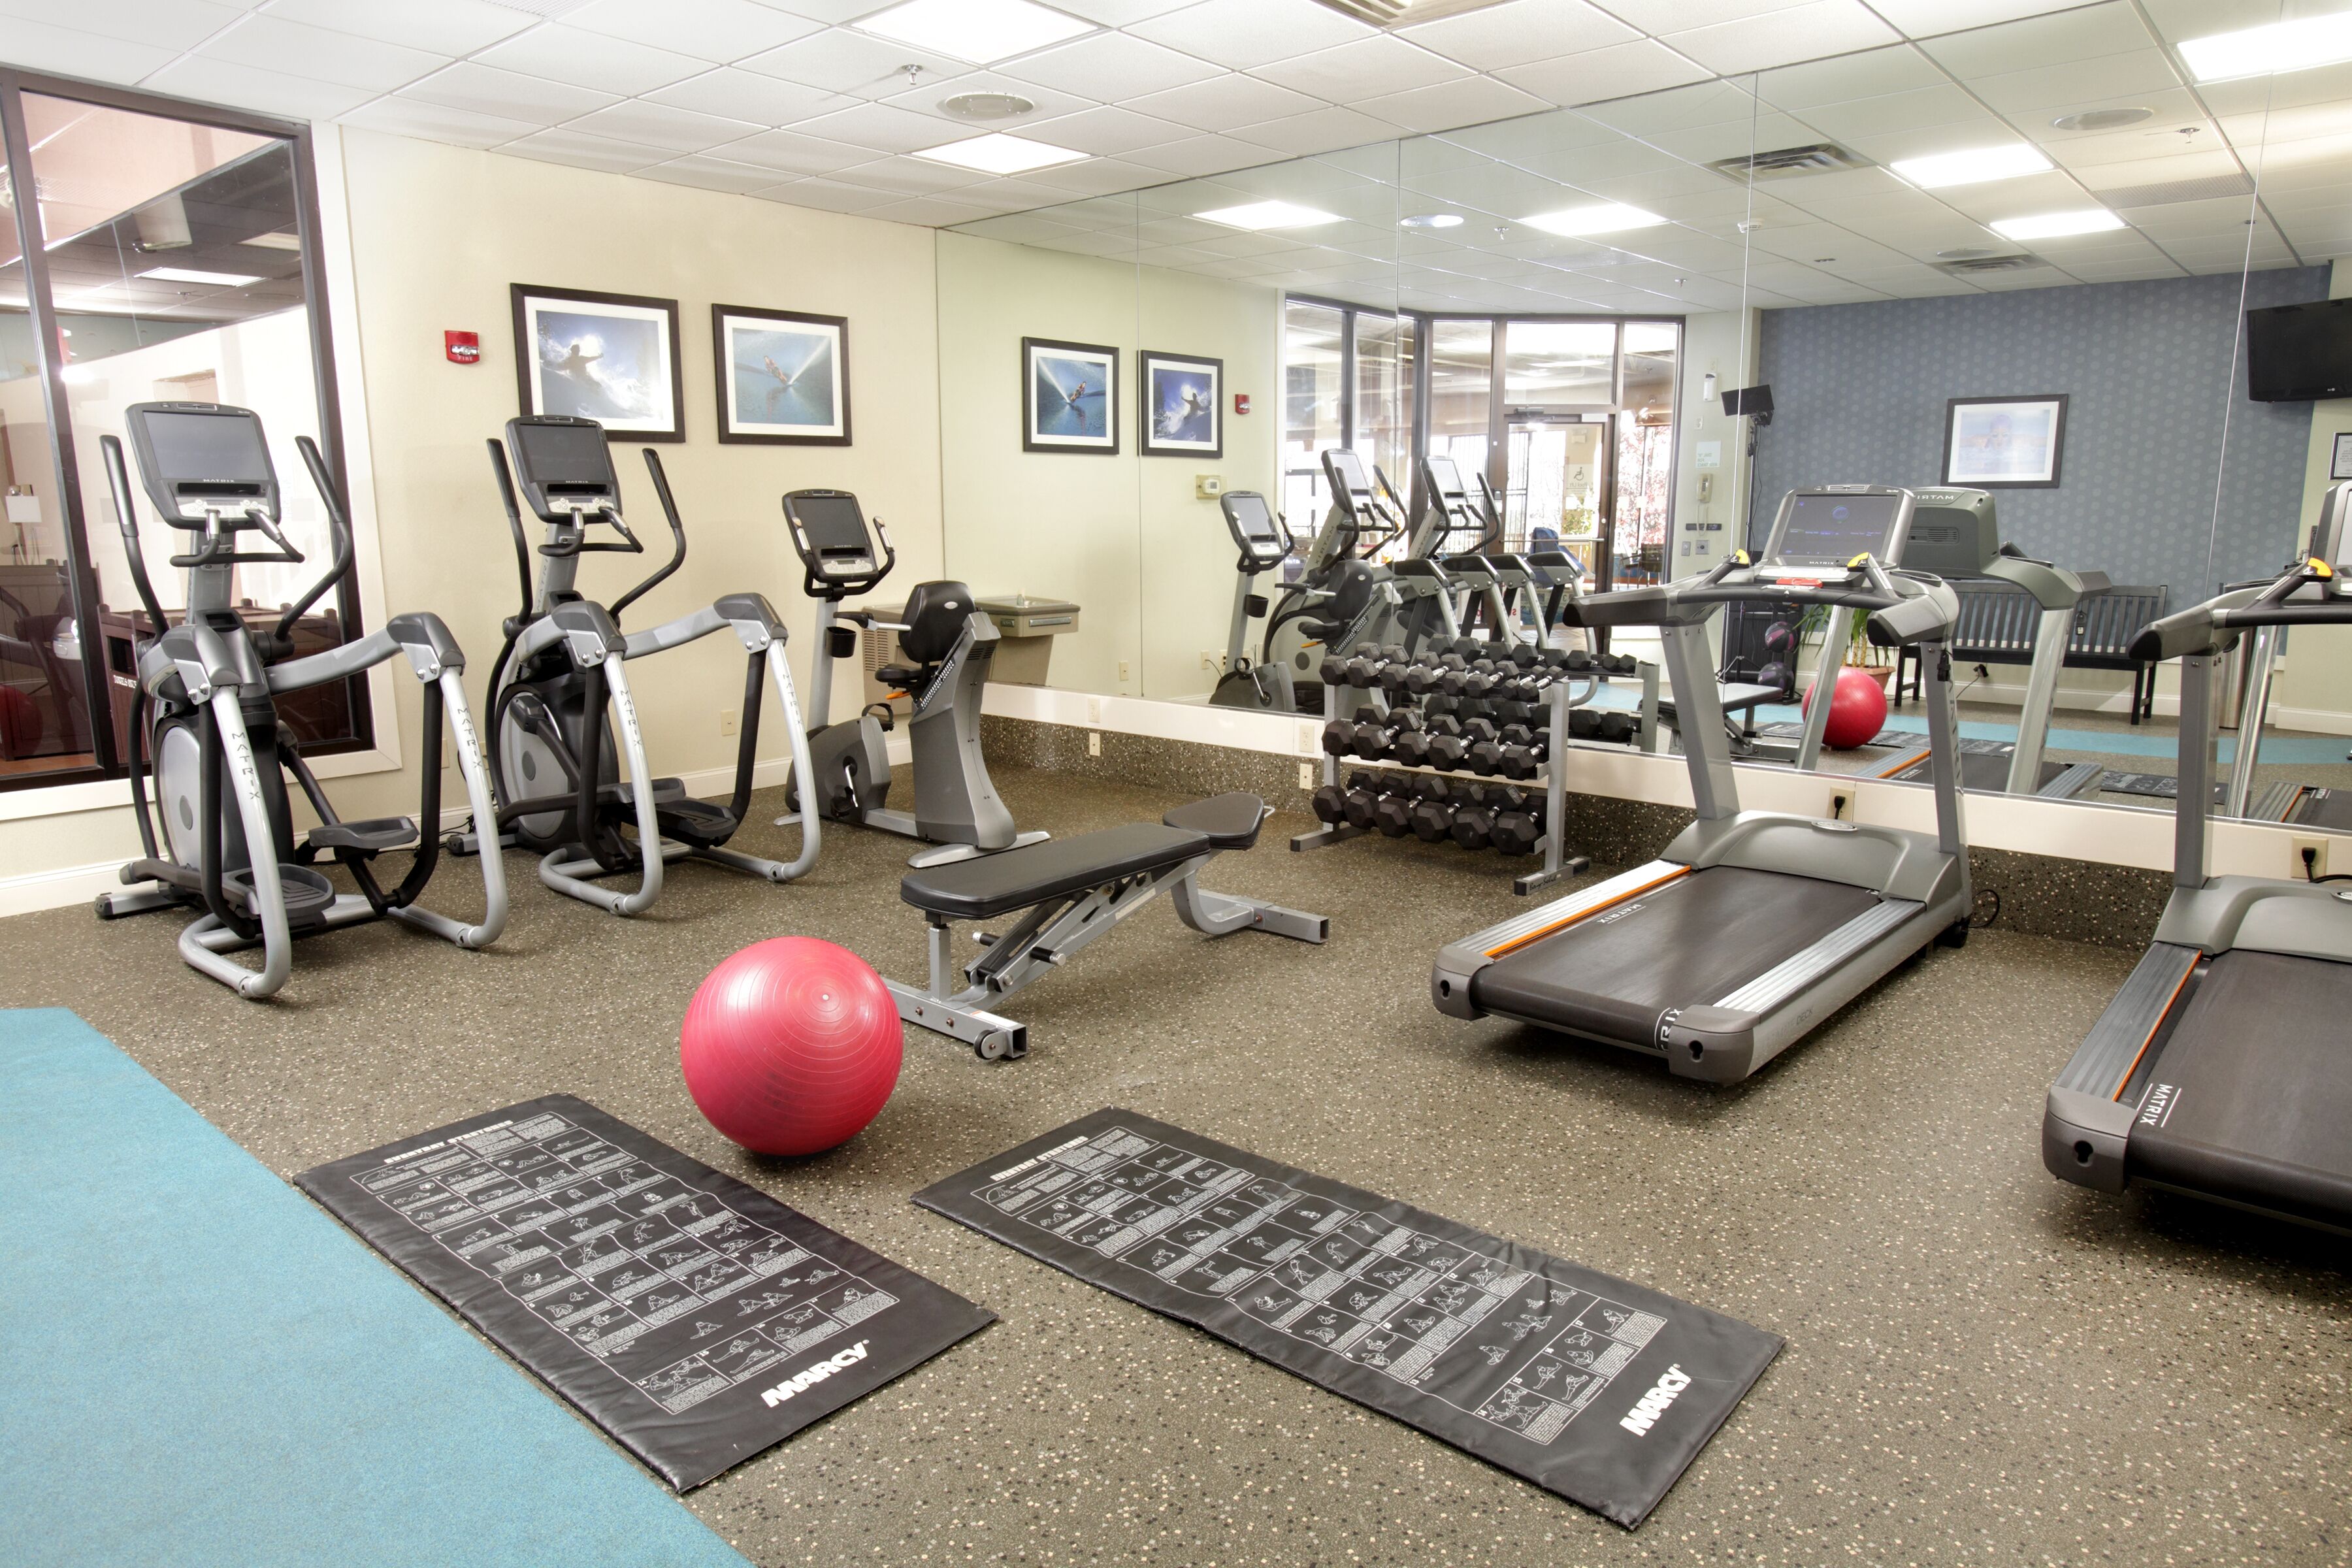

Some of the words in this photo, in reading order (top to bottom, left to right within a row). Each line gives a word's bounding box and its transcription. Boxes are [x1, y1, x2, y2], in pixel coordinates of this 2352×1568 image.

[457, 708, 483, 768] MATRIX
[620, 689, 643, 747] MATRIX
[231, 732, 261, 800] MATRIX
[1596, 904, 1642, 924] MATRIX
[2139, 1083, 2174, 1126] MATRIX
[760, 1341, 868, 1408] MARCY
[1619, 1366, 1692, 1437] MARCY
